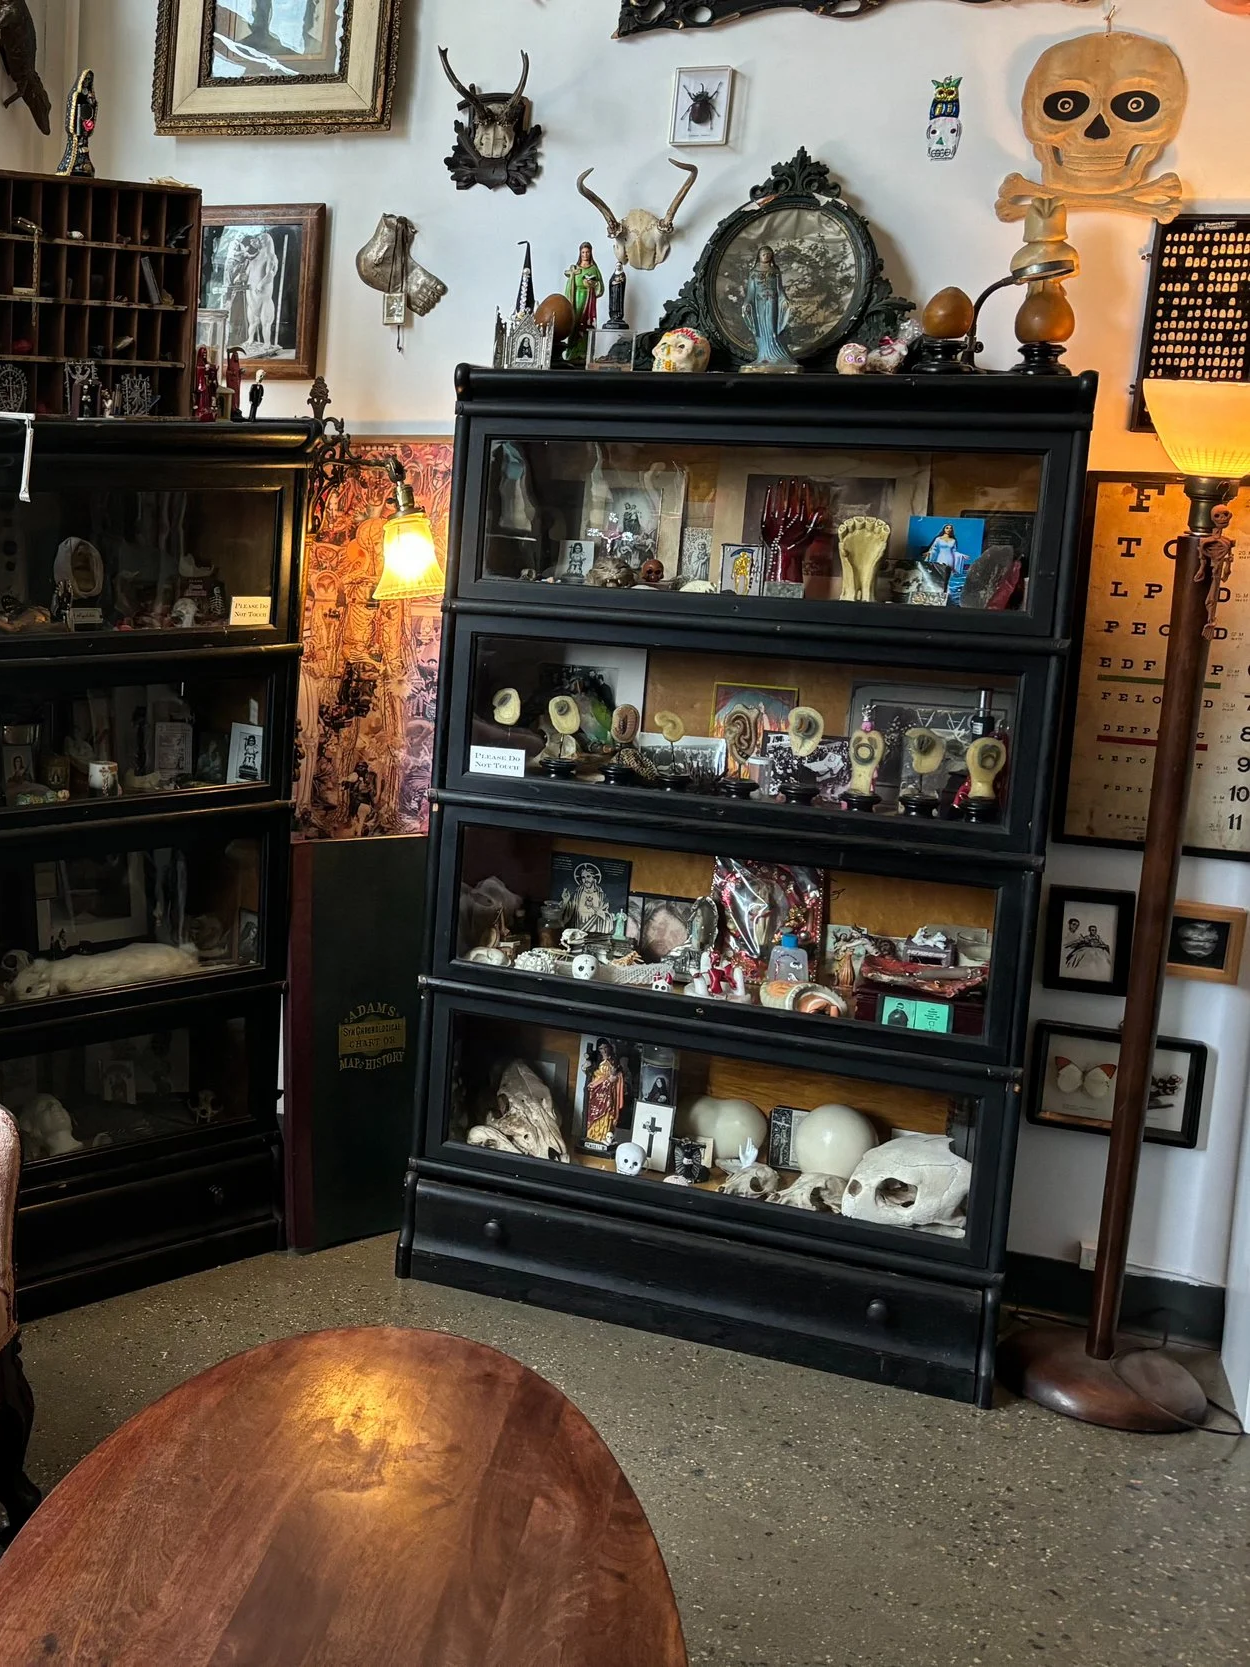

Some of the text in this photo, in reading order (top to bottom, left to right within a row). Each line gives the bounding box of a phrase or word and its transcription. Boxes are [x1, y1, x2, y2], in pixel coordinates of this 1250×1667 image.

[1128, 483, 1166, 513] F
[1117, 537, 1142, 558] T
[1109, 581, 1128, 597] L
[1143, 583, 1163, 599] P
[1103, 620, 1119, 634] P
[1131, 622, 1147, 635] E
[474, 752, 507, 761] PLEASE
[1237, 756, 1250, 773] 9
[493, 762, 520, 771] TOUCH
[1229, 785, 1250, 802] 10
[1227, 813, 1243, 831] 11
[349, 1037, 380, 1049] CHART
[339, 1058, 360, 1072] MAP
[364, 1051, 405, 1070] HISTORY
